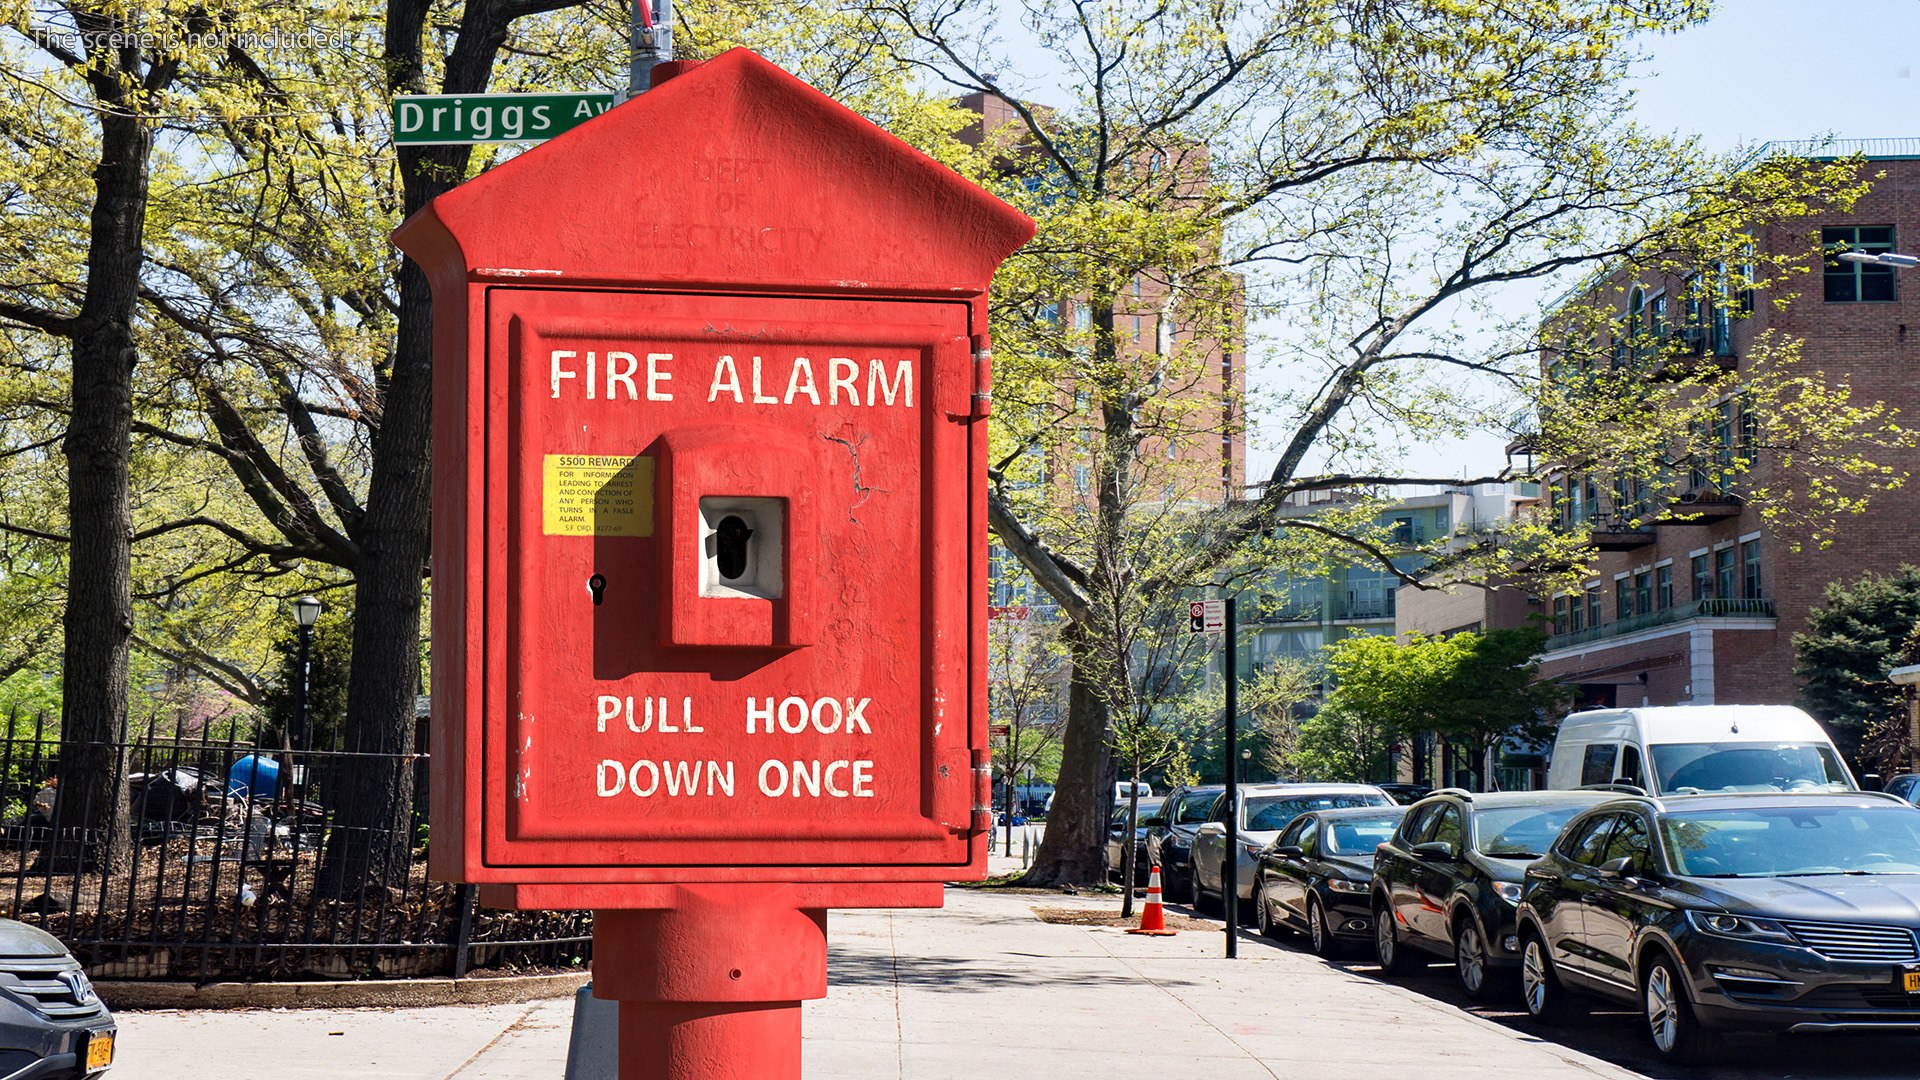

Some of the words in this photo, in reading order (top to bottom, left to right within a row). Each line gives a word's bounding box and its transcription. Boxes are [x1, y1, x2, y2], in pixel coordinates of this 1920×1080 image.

[401, 99, 550, 140] Driggs
[715, 191, 748, 213] OF
[633, 222, 826, 254] ELECTRICITY
[551, 350, 674, 402] FIRE
[707, 355, 914, 407] ALARM
[559, 457, 586, 466] $500
[588, 457, 635, 467] REWARD
[583, 471, 634, 479] INFORMATION
[597, 695, 704, 733] PULL
[746, 696, 872, 734] HOOK
[596, 759, 734, 797] DOWN
[758, 759, 874, 798] ONCE
